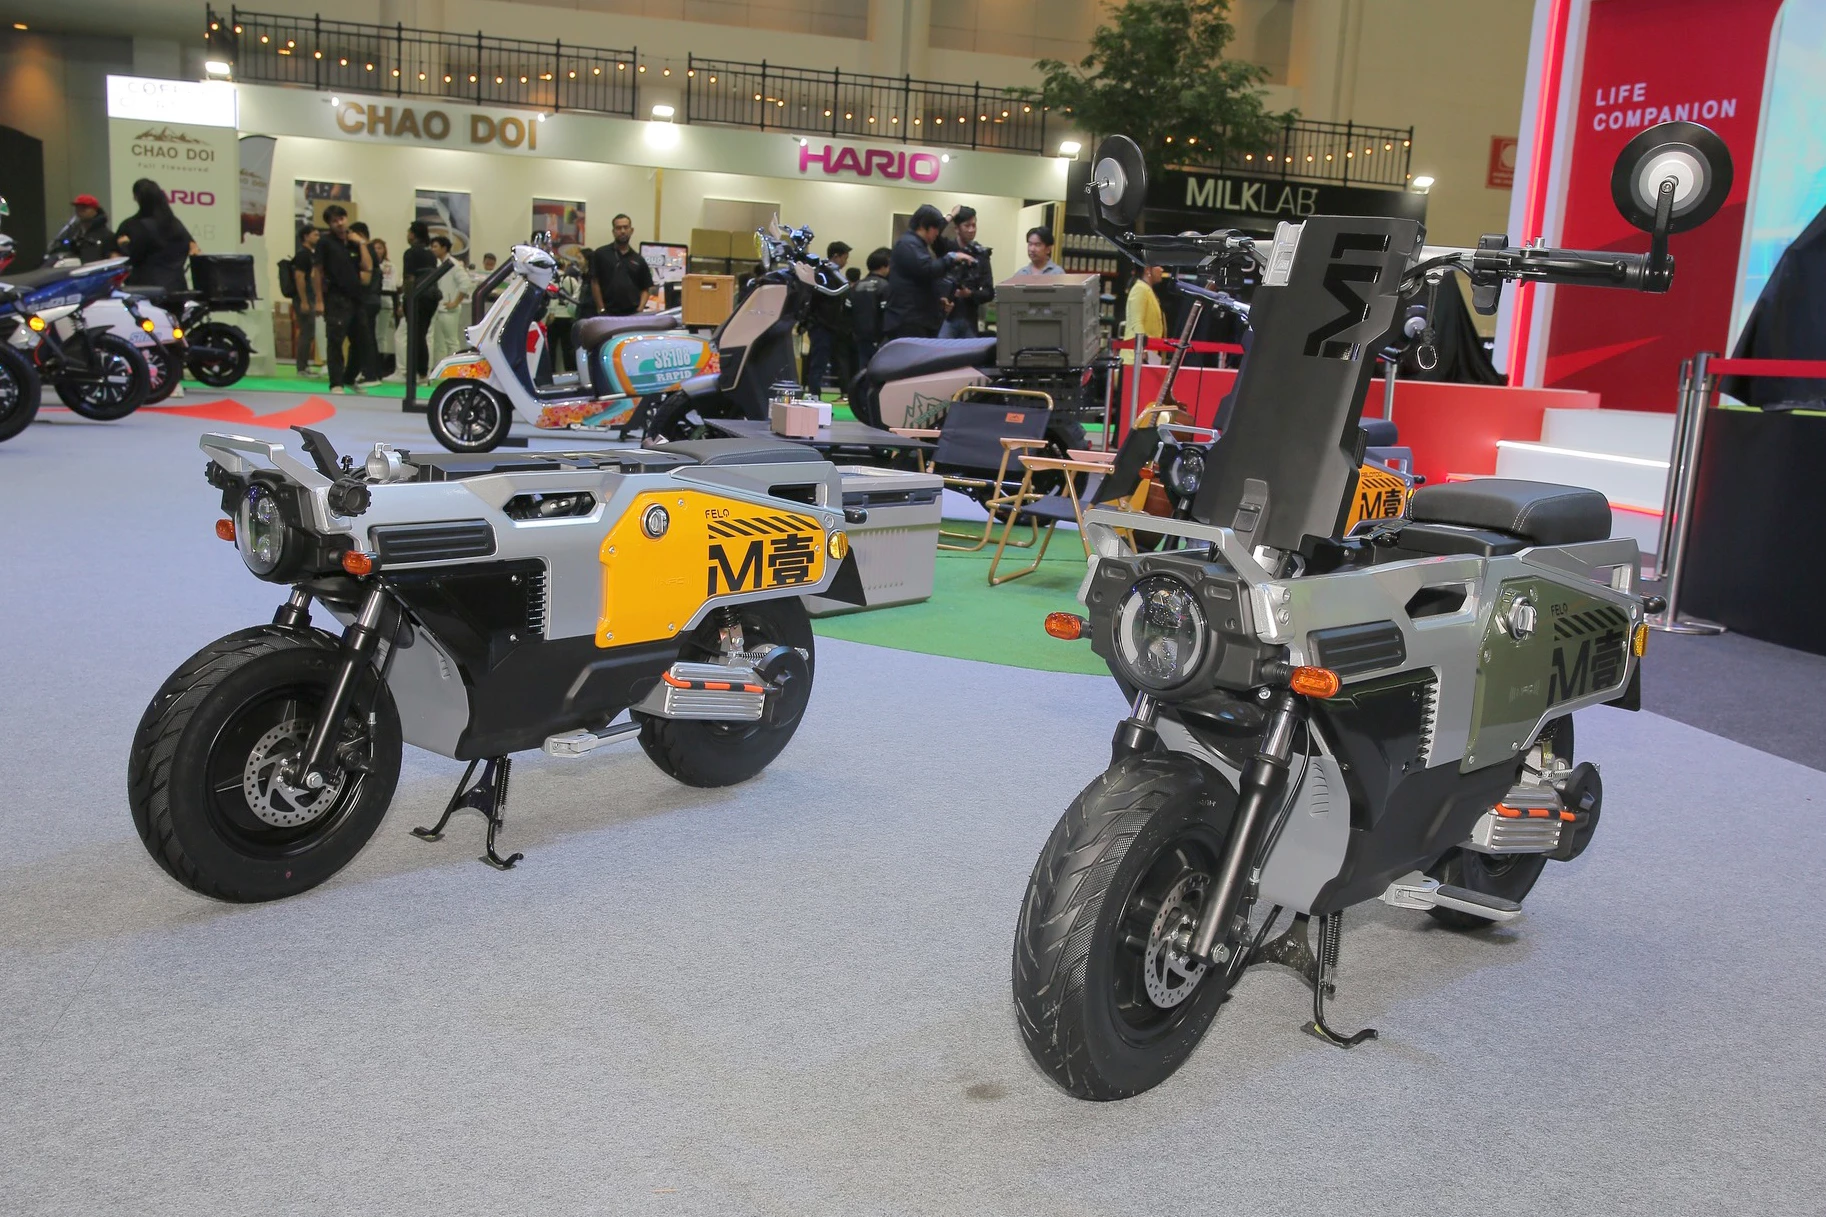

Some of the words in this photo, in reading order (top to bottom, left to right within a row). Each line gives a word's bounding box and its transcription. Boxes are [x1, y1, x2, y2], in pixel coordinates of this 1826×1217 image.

[1595, 82, 1647, 106] LIFE
[336, 101, 451, 140] CHAO
[470, 113, 537, 150] DOI
[1593, 98, 1737, 131] COMPANION
[131, 143, 178, 159] CHAO
[186, 148, 215, 162] DOI
[798, 144, 940, 184] HARIO
[1185, 176, 1318, 216] MILKLAB
[654, 349, 691, 369] SR108
[655, 370, 692, 382] RAPID
[704, 508, 730, 519] FELO
[1550, 603, 1569, 617] FELO
